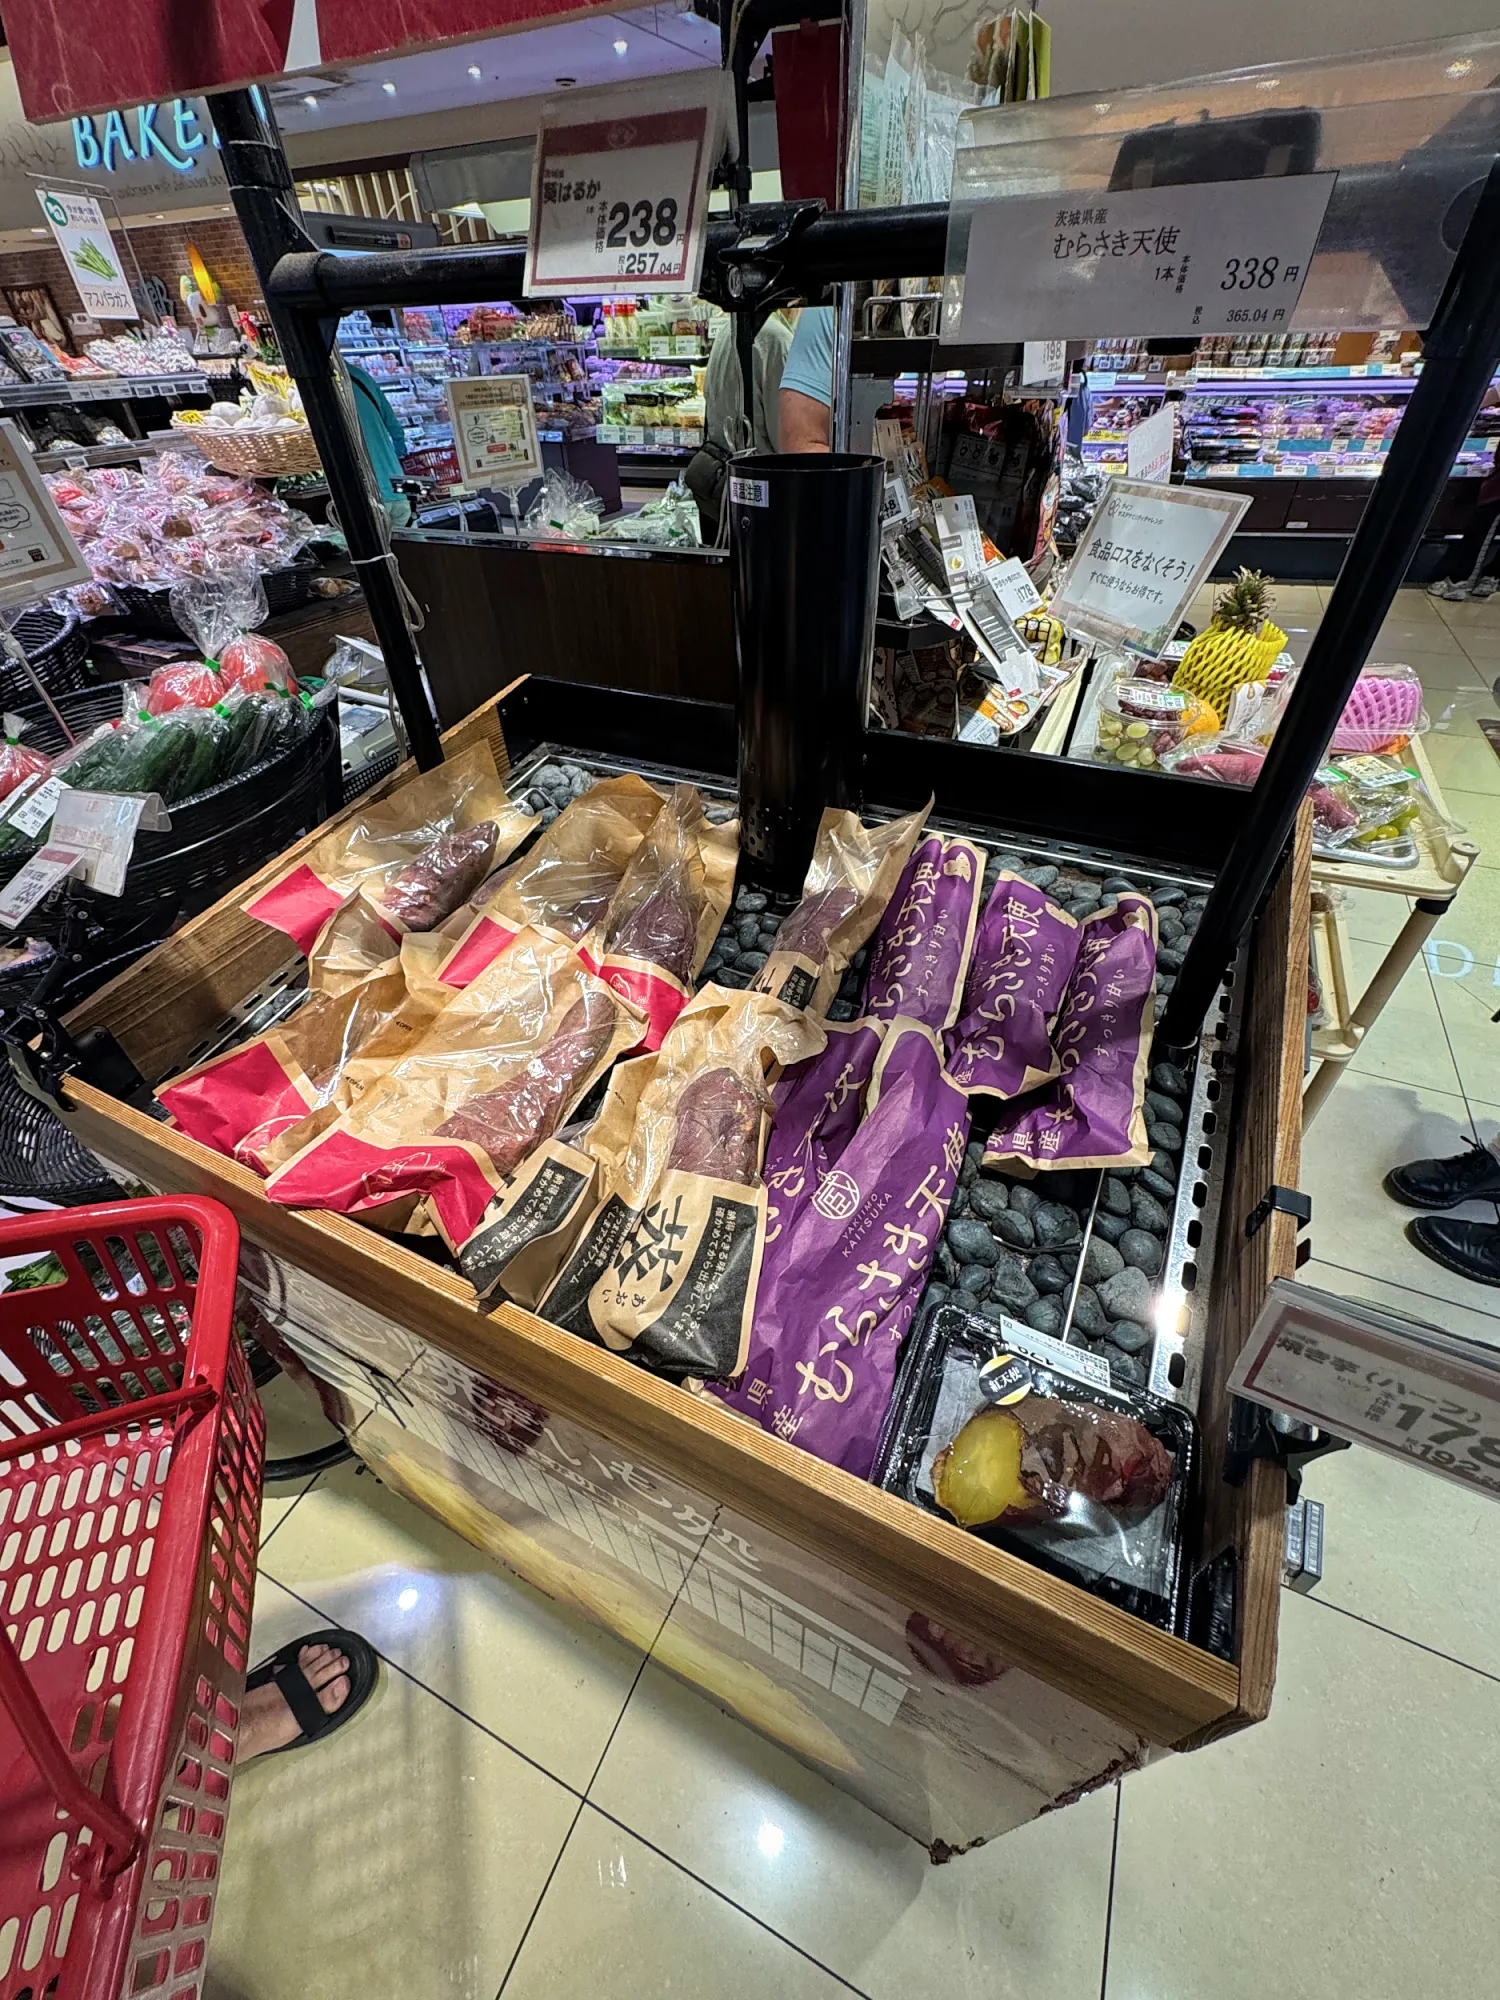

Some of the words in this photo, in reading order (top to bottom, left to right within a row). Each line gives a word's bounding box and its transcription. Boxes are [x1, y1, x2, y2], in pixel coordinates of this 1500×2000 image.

[72, 98, 222, 172] BAKE
[1055, 208, 1108, 228] 茨城県産
[1054, 225, 1180, 259] むらさき天使
[84, 290, 131, 308] アスパラガス
[1089, 570, 1165, 605] すぐに使うならお得です。
[961, 897, 1044, 1062] むらさき天使
[841, 1191, 894, 1259] KAITSUKA
[842, 1192, 880, 1240] YAKIIMO
[794, 1121, 967, 1404] むらさき天使
[988, 1368, 1024, 1393] 紅天使
